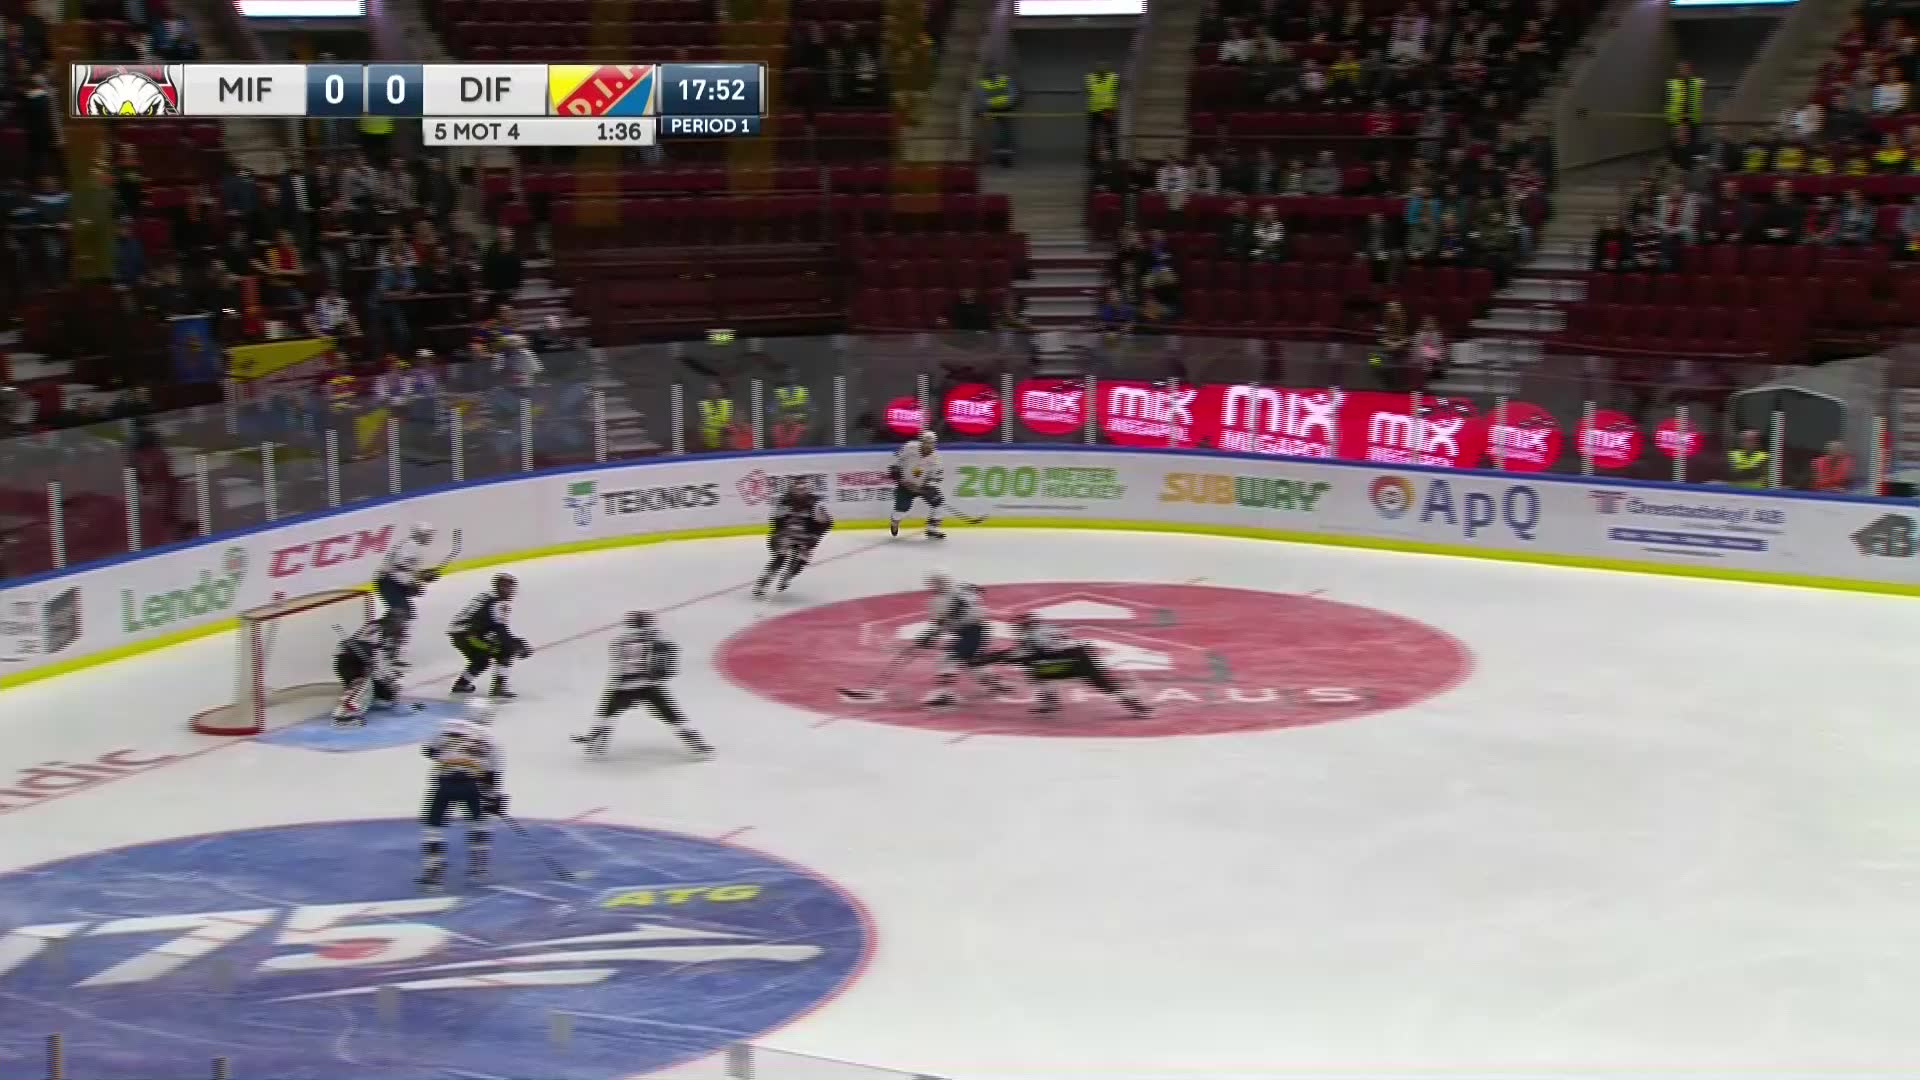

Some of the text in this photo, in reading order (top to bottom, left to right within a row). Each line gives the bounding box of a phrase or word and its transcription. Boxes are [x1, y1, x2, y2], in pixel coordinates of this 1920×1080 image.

[1106, 385, 1200, 426] mix
[1220, 384, 1348, 440] mix
[600, 484, 721, 517] TEKNOS
[955, 466, 1040, 499] 200
[1160, 473, 1332, 511] SUBWAY
[1420, 479, 1541, 542] ApQ
[270, 527, 395, 579] CCM
[121, 568, 238, 634] Lendo
[600, 885, 764, 908] ATG
